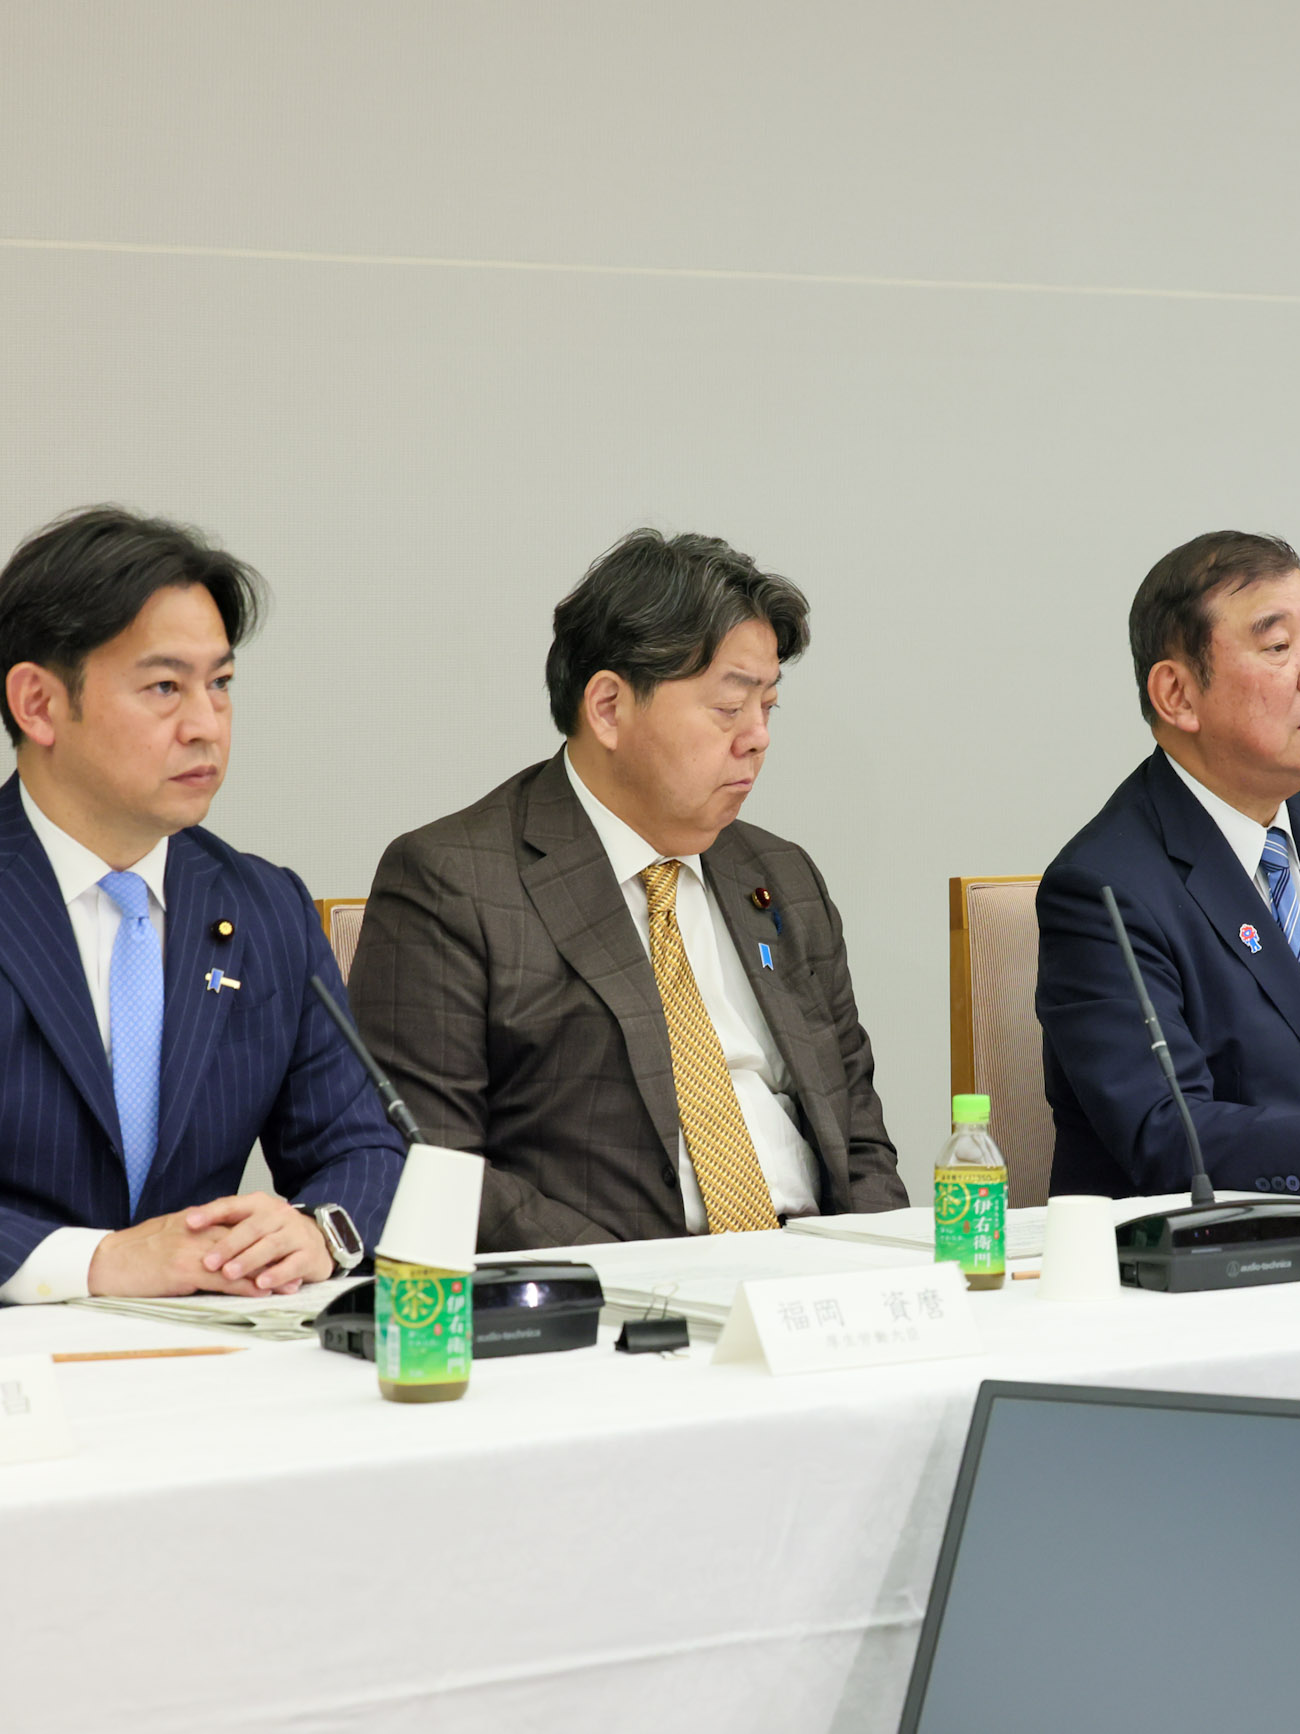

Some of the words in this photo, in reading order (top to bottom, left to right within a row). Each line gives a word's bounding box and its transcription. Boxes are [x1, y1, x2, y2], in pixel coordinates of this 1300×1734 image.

[973, 1198, 992, 1268] 伊右衛門
[401, 1279, 435, 1320] 茶
[777, 1298, 845, 1332] 福岡
